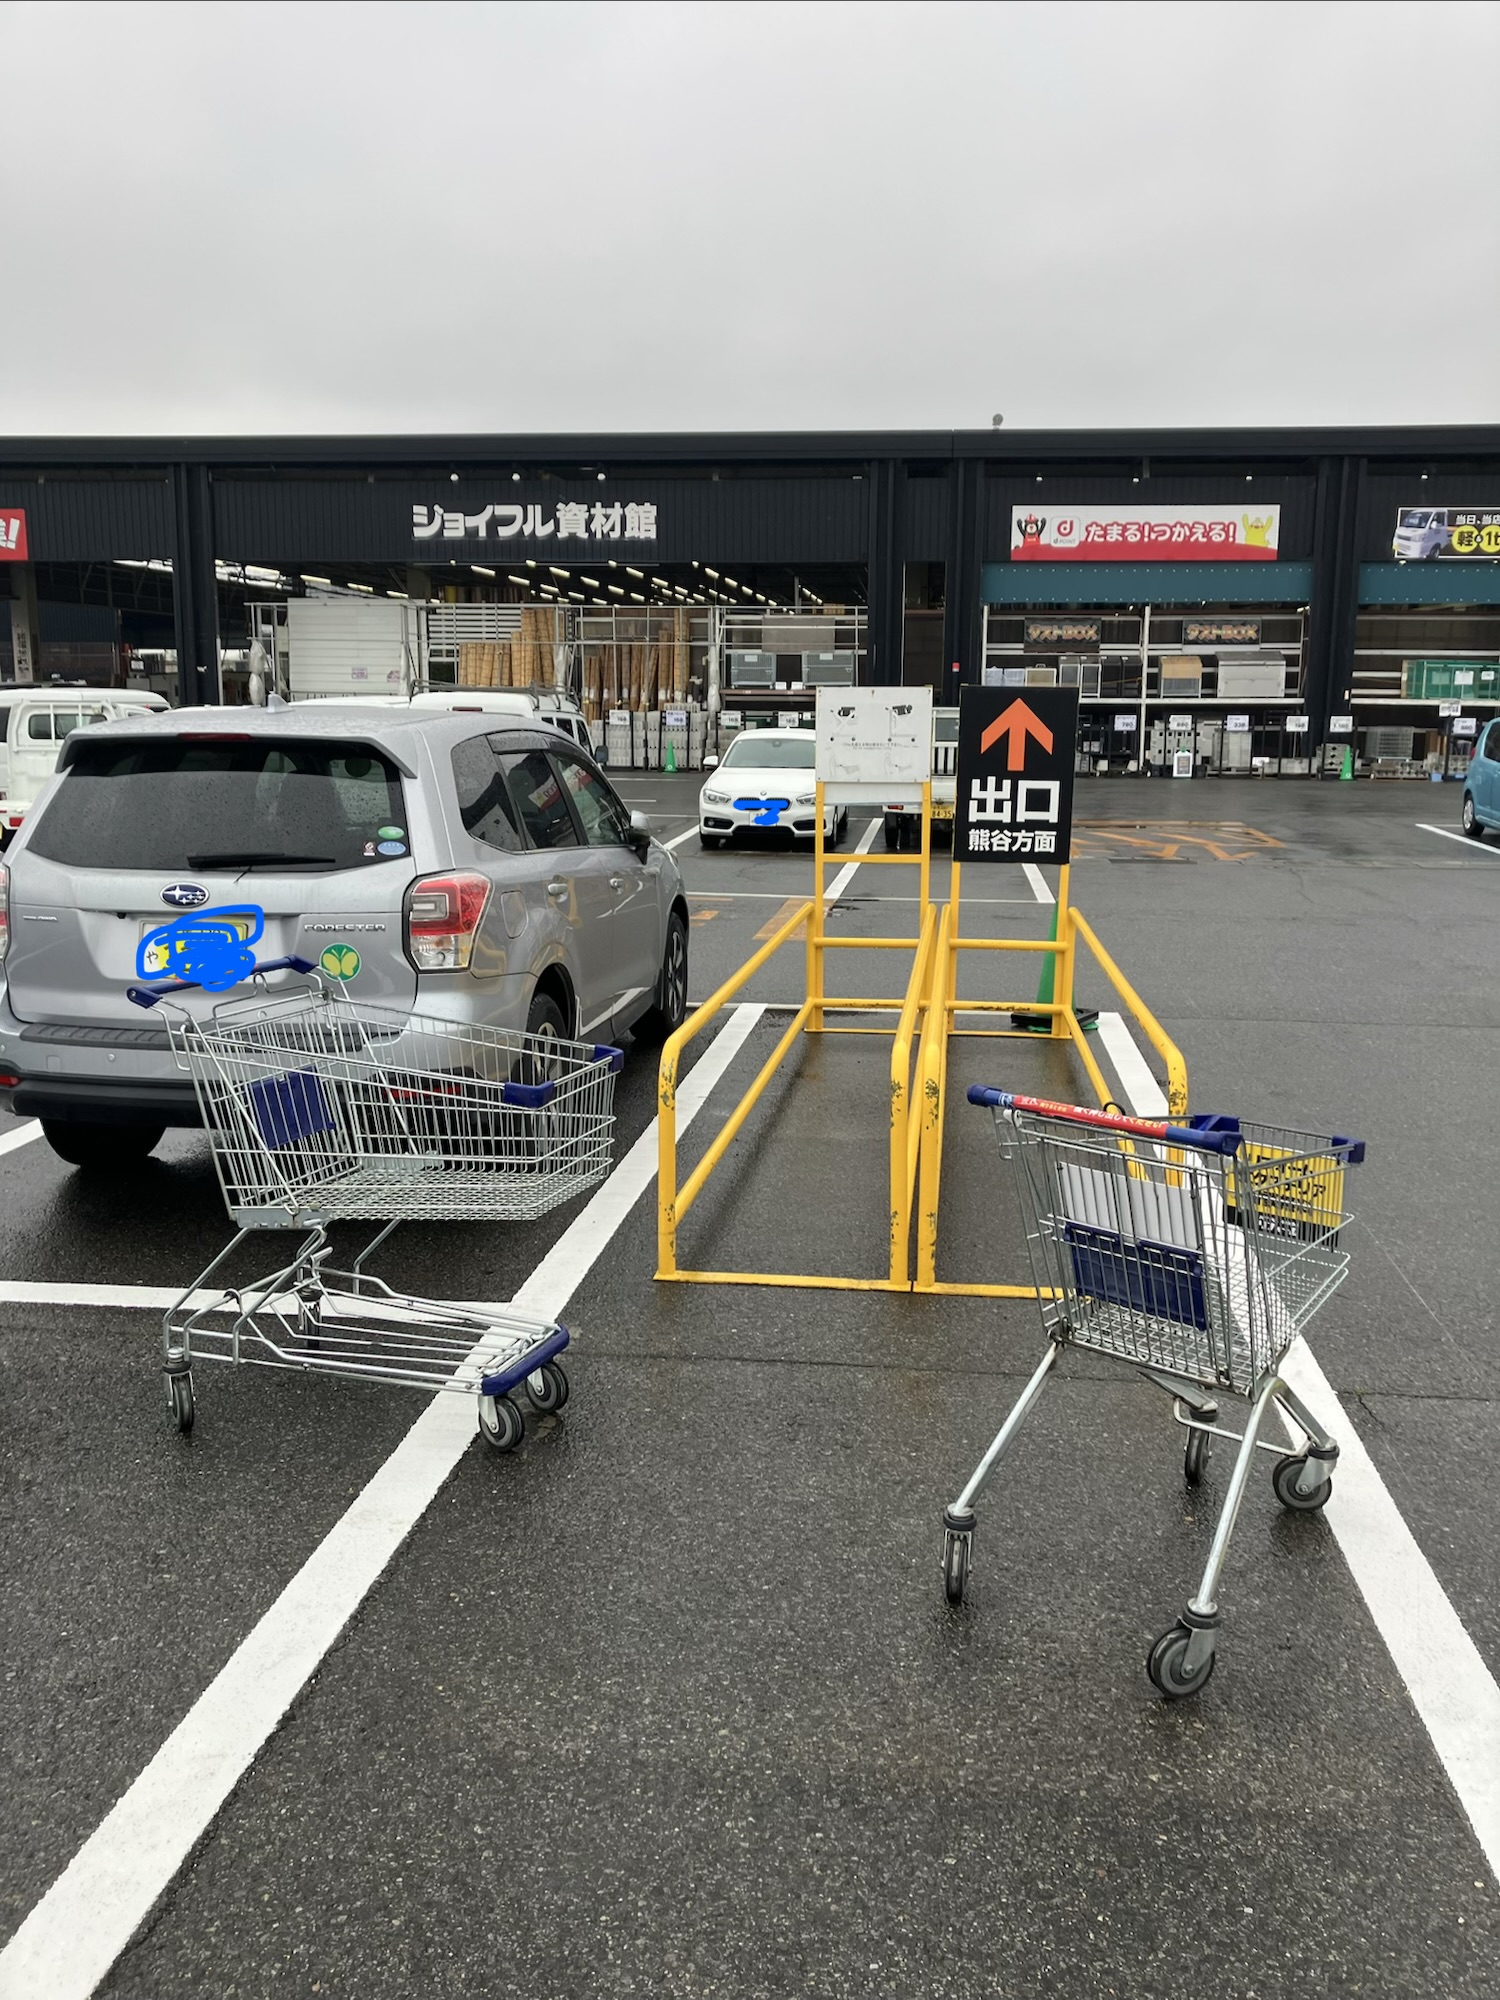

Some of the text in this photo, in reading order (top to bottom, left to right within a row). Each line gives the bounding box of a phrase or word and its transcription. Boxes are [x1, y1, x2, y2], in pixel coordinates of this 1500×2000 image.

[412, 502, 658, 540] ジョイフル資材館
[1086, 521, 1236, 542] たまる!つかえる!
[1028, 624, 1098, 641] ダストBOX
[1186, 624, 1258, 641] ダストBOX
[968, 776, 1061, 823] 出口
[968, 829, 1057, 853] 熊谷方面
[303, 923, 386, 932] FORESTER
